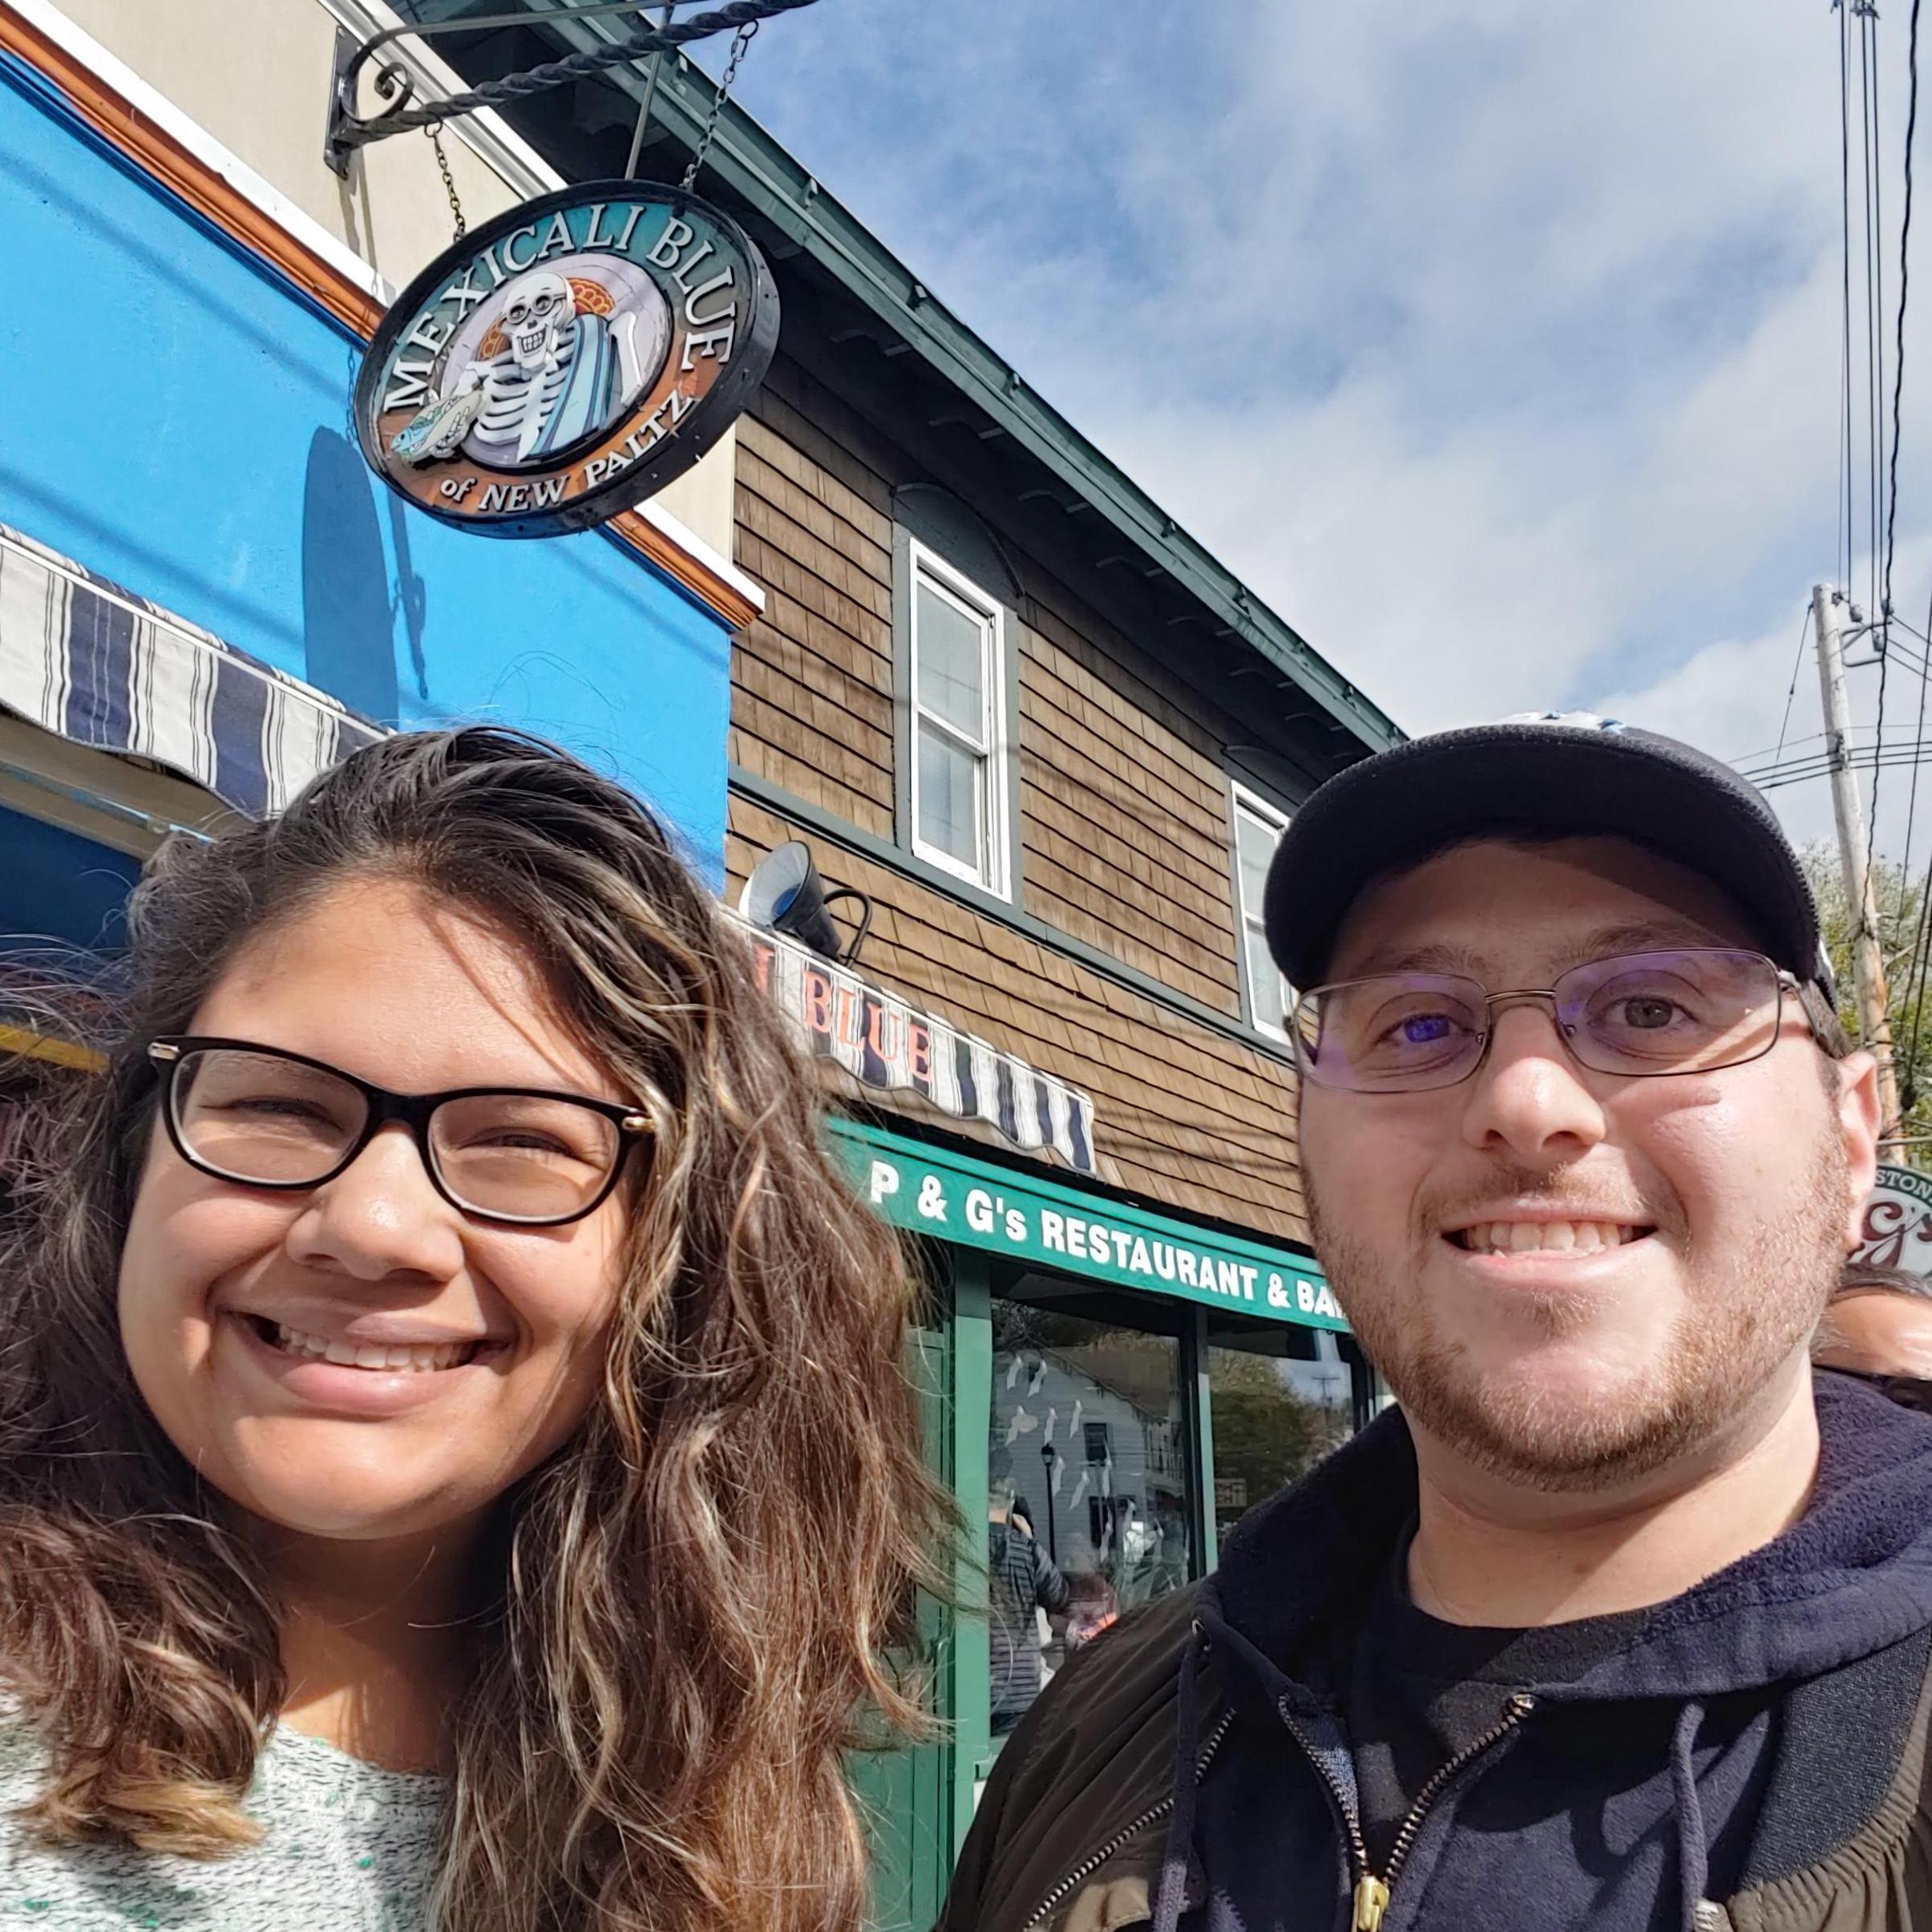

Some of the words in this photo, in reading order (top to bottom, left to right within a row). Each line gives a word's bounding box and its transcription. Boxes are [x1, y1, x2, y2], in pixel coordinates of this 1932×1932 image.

[384, 202, 645, 413] MEXICALI
[645, 216, 738, 371] BLUE
[440, 477, 475, 503] of
[478, 475, 569, 512] NEW
[584, 388, 695, 490] PALTZ
[805, 970, 932, 1082] BLUE
[871, 1160, 899, 1203] P
[918, 1174, 948, 1222] &
[966, 1189, 1027, 1241] G's
[1041, 1209, 1258, 1300] RESTAURANT
[1267, 1272, 1291, 1308] &
[1875, 1168, 1932, 1206] STON
